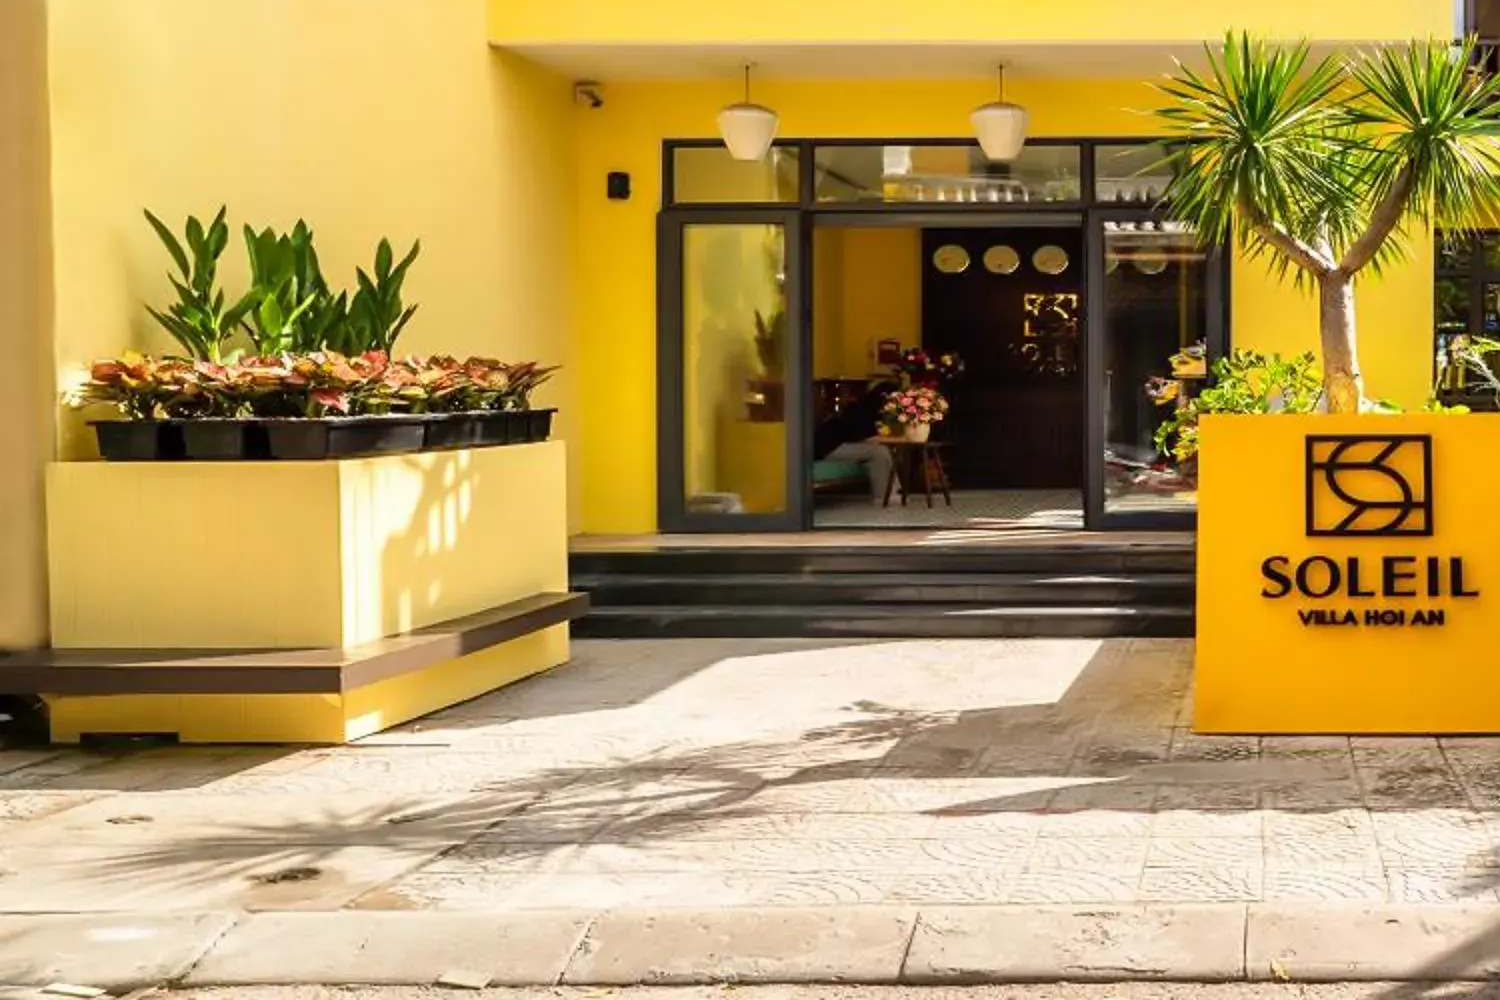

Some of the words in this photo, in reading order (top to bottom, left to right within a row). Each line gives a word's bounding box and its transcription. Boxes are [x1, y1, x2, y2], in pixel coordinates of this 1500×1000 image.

[1261, 555, 1479, 598] SOLEIL
[1298, 609, 1358, 627] VILLA
[1364, 609, 1405, 627] HOI
[1411, 609, 1445, 627] AN
